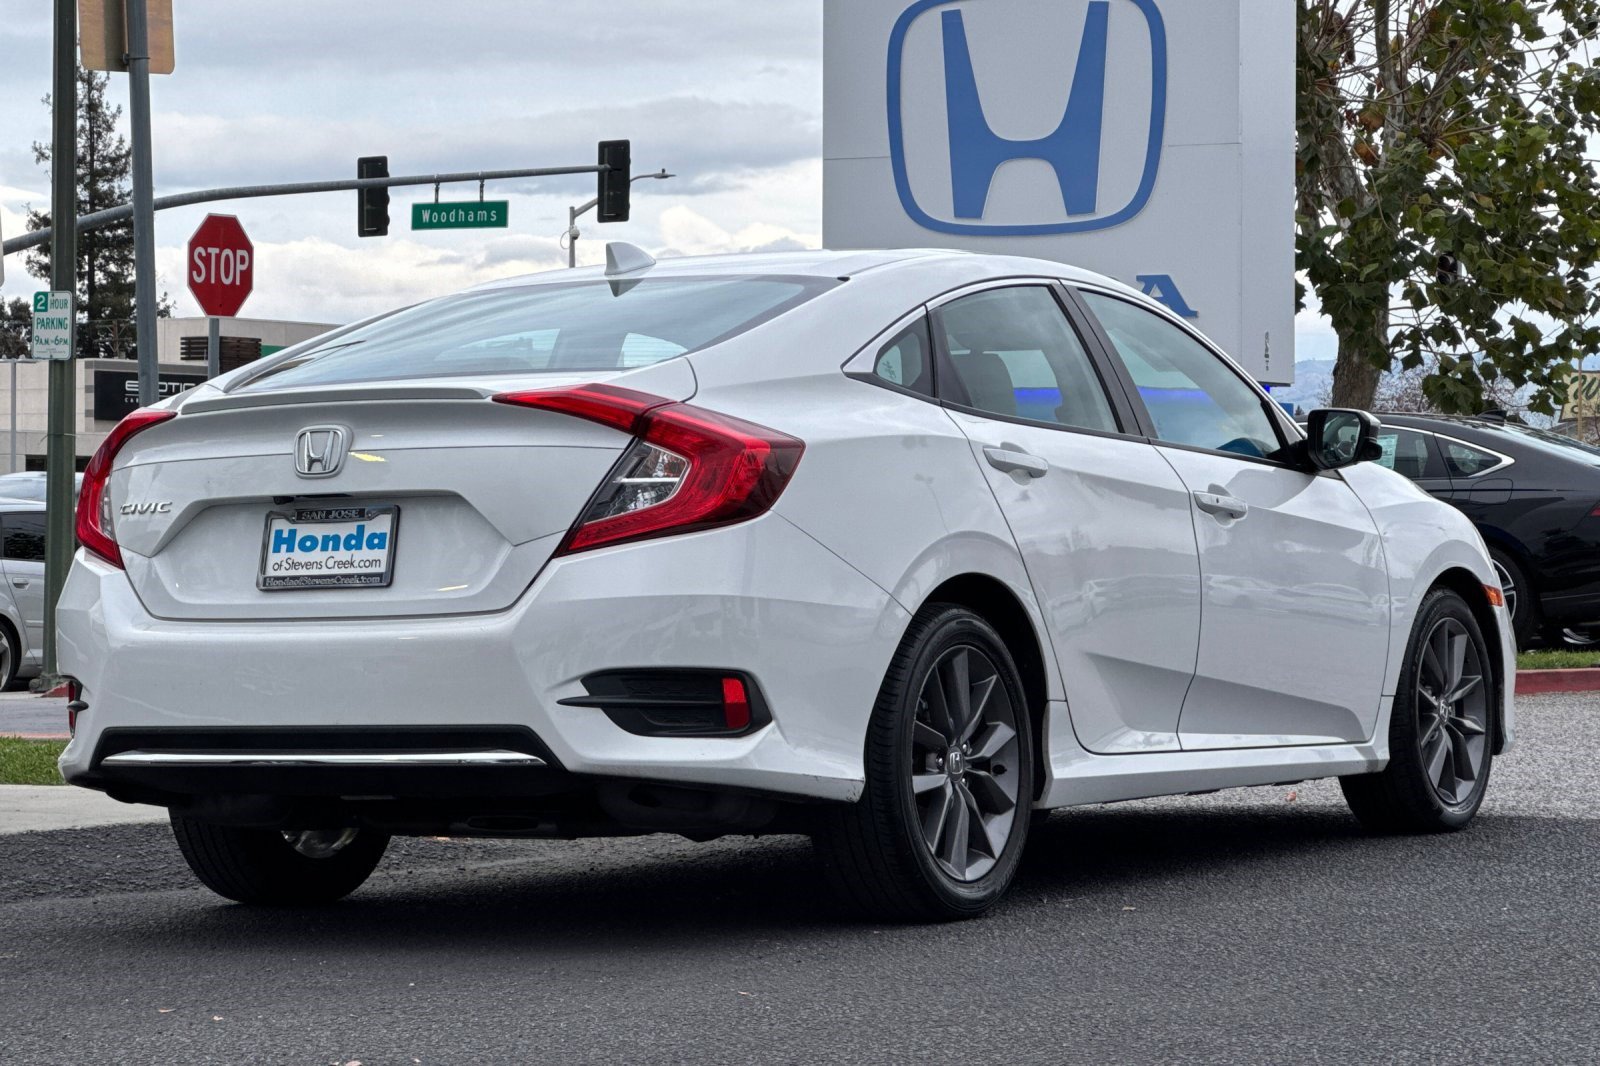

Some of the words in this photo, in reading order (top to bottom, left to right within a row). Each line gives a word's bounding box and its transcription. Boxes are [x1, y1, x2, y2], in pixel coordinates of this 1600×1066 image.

[421, 208, 497, 223] Woodhams
[192, 246, 250, 286] STOP
[36, 294, 46, 310] 2
[50, 299, 68, 309] HOUR
[36, 317, 68, 330] PARKING
[120, 501, 173, 515] CIVIC
[302, 511, 326, 520] SAN
[329, 509, 359, 519] JOSE
[272, 524, 387, 553] Honda
[272, 560, 284, 571] of
[285, 556, 323, 570] Stevens
[325, 554, 381, 570] Creek.com
